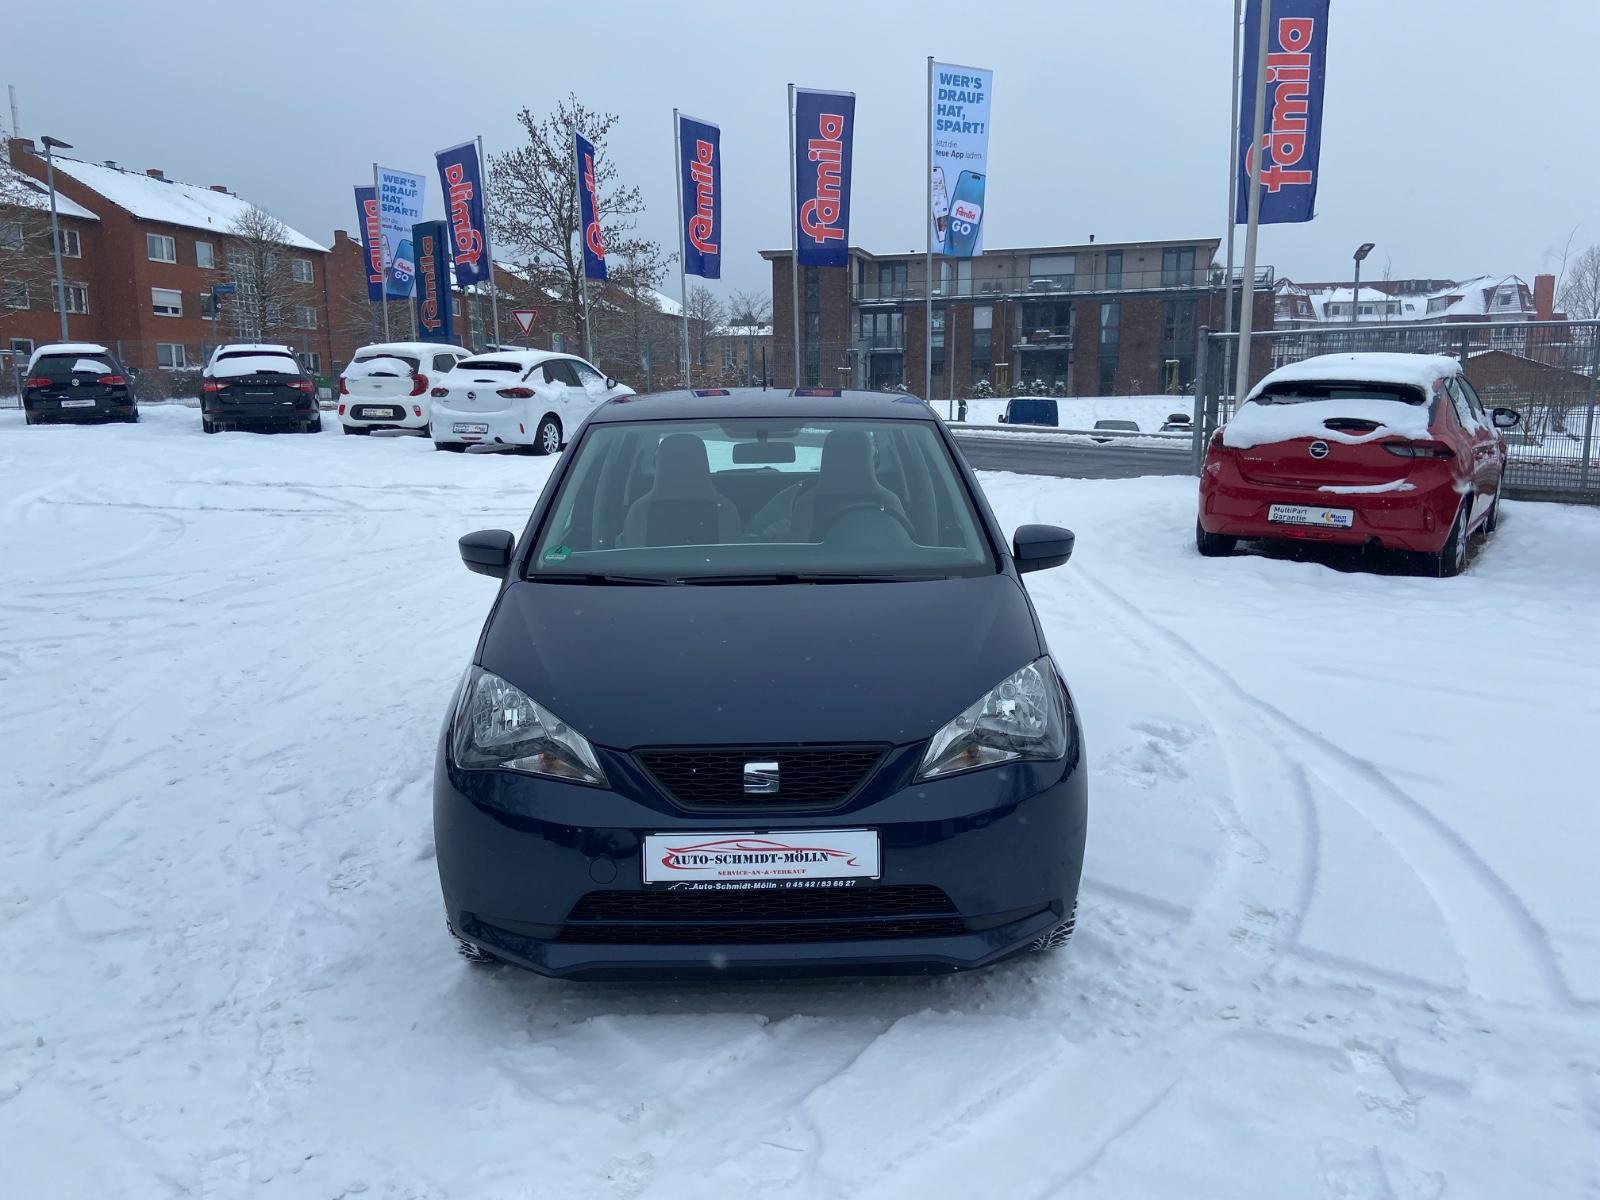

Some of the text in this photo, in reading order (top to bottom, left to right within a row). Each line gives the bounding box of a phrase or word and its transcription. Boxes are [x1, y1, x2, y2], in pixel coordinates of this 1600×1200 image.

[939, 73, 982, 89] WER'S
[938, 88, 984, 104] DRAUF
[937, 103, 966, 120] HAT,
[1245, 18, 1314, 193] famila
[936, 118, 985, 134] SPART!
[951, 150, 964, 160] App
[383, 174, 417, 188] WER'S
[801, 113, 844, 243] famila
[382, 184, 418, 198] DRAUF
[689, 139, 717, 256] famila
[381, 193, 404, 206] HAT,
[381, 204, 418, 217] SPART!
[951, 220, 971, 236] GO
[394, 271, 409, 282] GO
[420, 236, 441, 332] famila
[1272, 513, 1306, 522] Garantie
[1274, 506, 1308, 515] MultiPart
[672, 850, 829, 866] AUTO-SCHMIDT-MÖLLN
